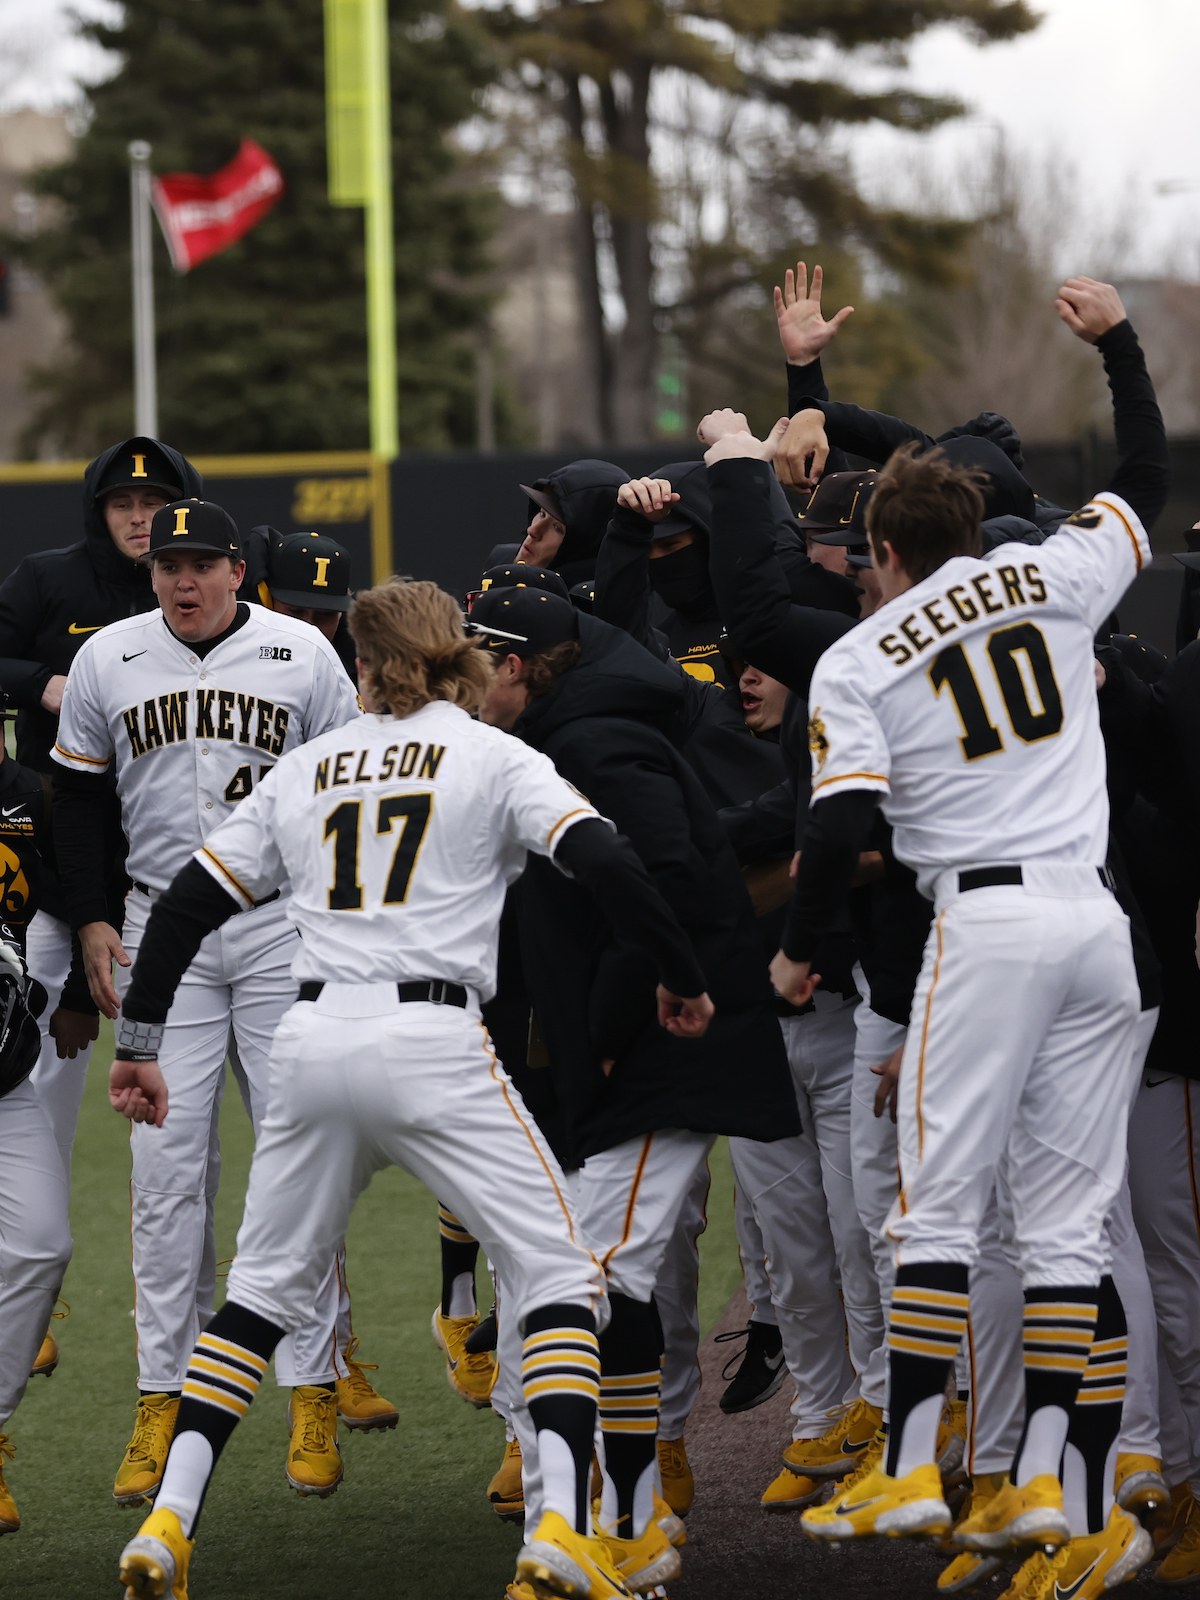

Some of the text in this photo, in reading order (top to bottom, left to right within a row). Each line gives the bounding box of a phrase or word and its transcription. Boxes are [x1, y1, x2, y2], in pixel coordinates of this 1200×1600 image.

[131, 453, 148, 478] I
[172, 507, 190, 536] I
[312, 557, 331, 587] I
[877, 563, 1048, 667] SEEGERS
[925, 620, 1064, 763] 10
[122, 688, 289, 761] HAWKEYES
[313, 741, 447, 797] NELSON
[321, 791, 434, 911] 17
